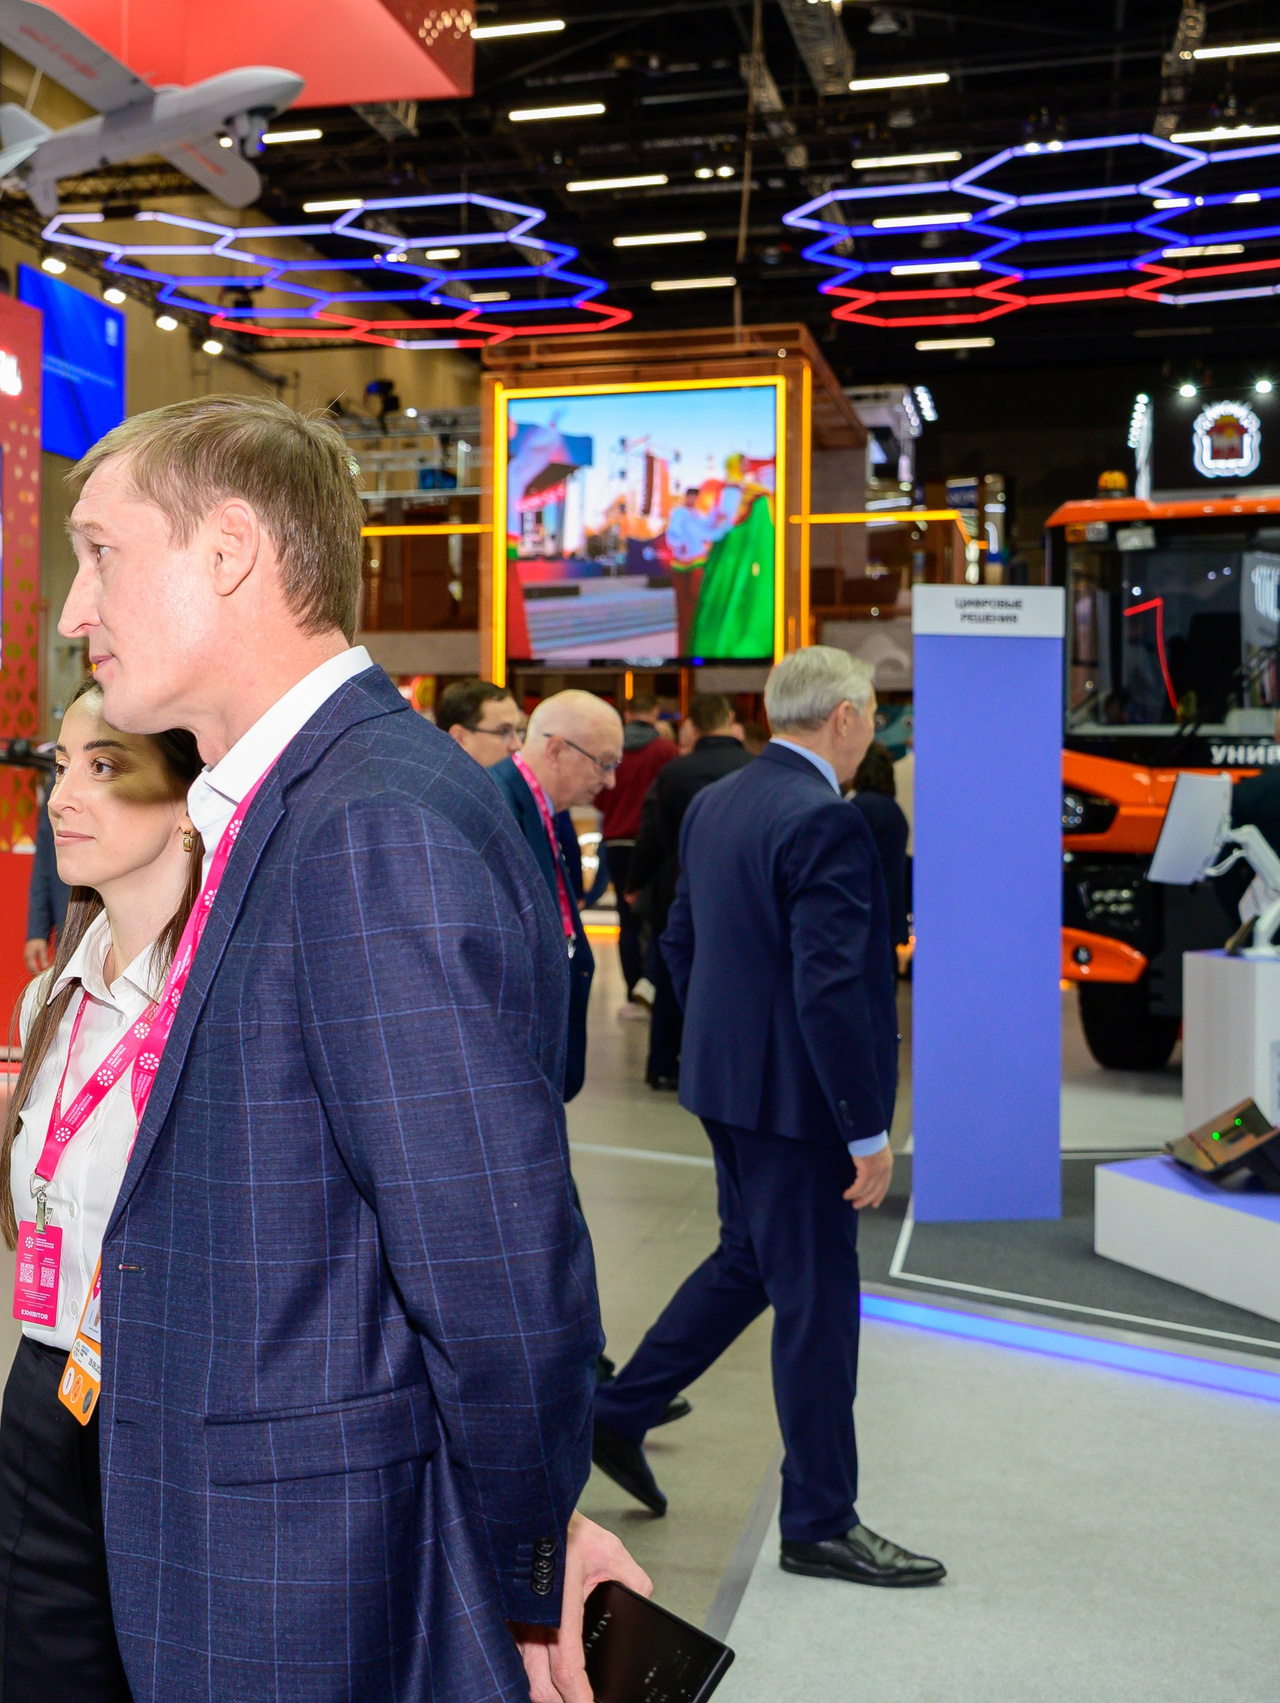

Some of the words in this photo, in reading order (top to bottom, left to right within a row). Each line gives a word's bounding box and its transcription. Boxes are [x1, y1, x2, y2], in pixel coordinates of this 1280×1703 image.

[954, 597, 1023, 610] ЦИФРОВЫЕ
[960, 613, 1018, 623] РЕШЕНИЯ
[20, 1308, 49, 1321] EXHIBITOR
